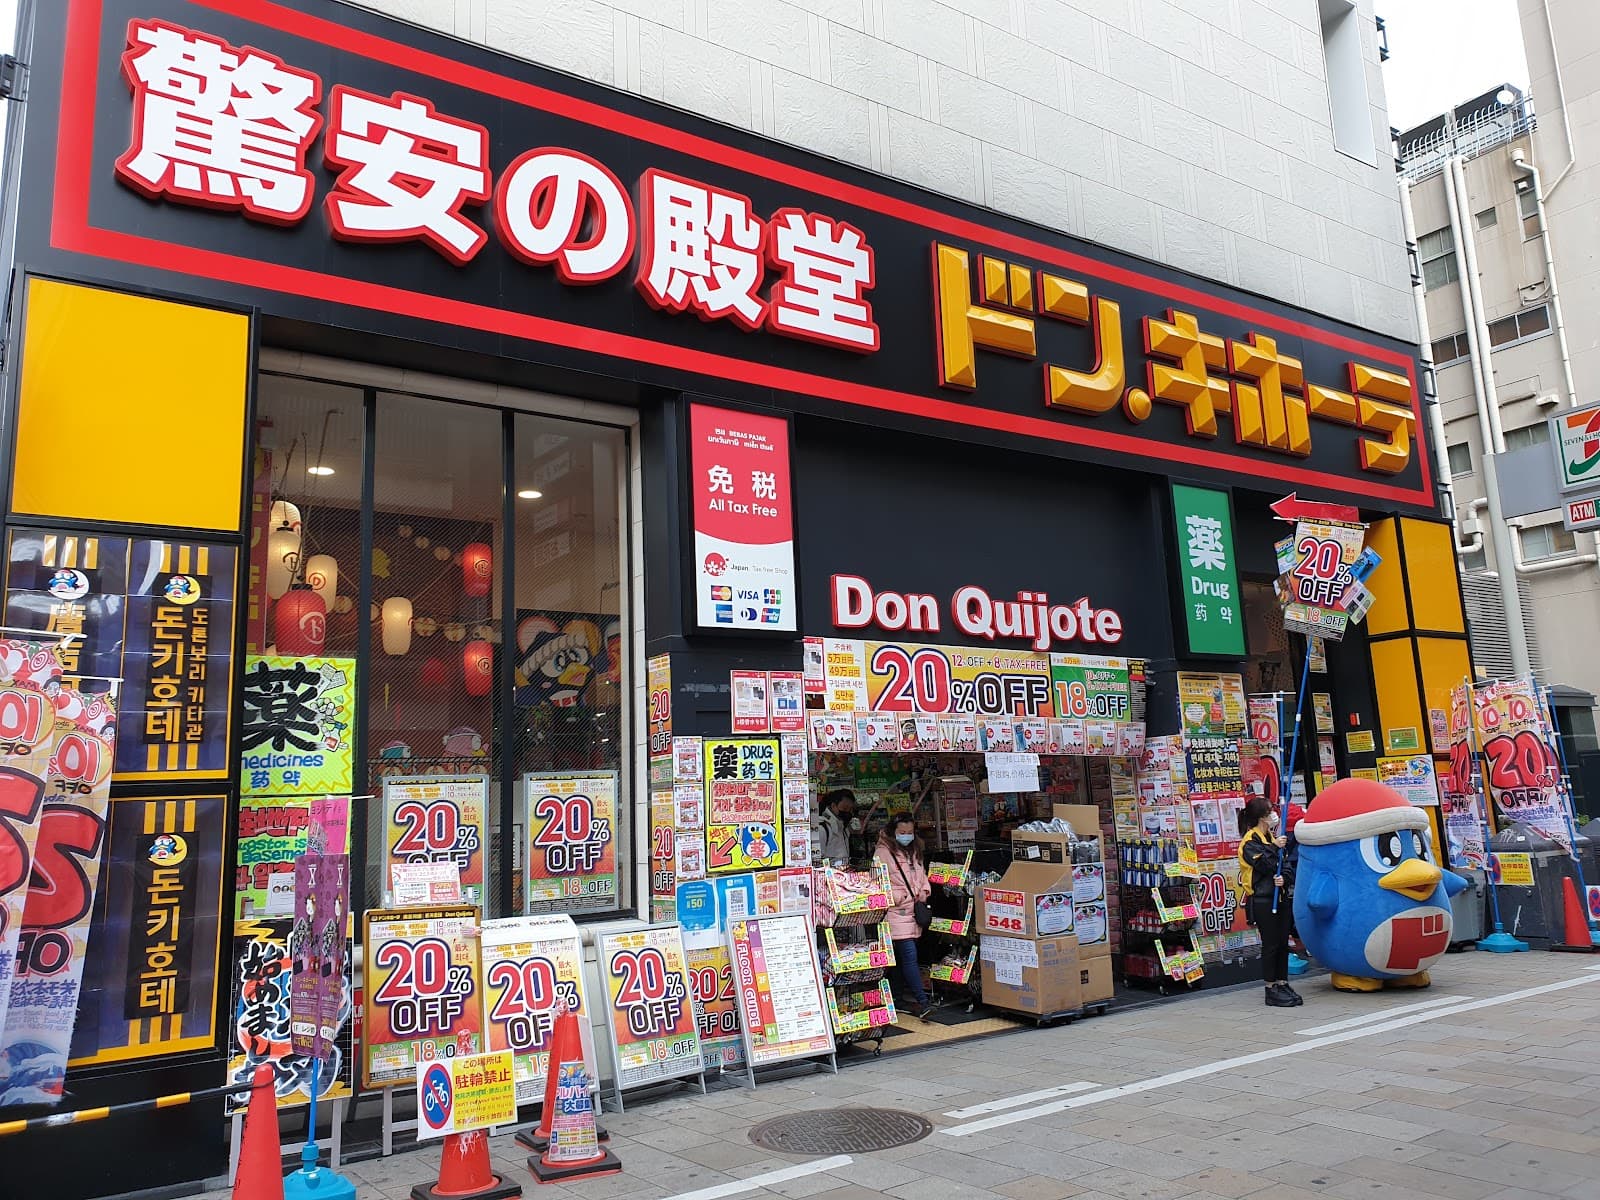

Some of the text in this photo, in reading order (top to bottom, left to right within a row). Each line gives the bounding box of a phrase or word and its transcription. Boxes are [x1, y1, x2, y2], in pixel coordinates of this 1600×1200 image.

[117, 18, 881, 354] 驚安の殿堂
[709, 498, 778, 517] All Tax Free
[1572, 502, 1595, 520] ATM
[1185, 514, 1226, 572] 薬
[731, 563, 749, 571] Japan
[1294, 536, 1354, 584] 20%
[737, 590, 760, 600] VISA
[1191, 576, 1231, 600] Drug
[1298, 577, 1345, 606] OFF
[831, 574, 1125, 652] Don Quijote
[1194, 602, 1208, 623] 药
[1219, 606, 1233, 624] 약
[145, 604, 186, 743] 돈키호테
[967, 656, 985, 667] OFF
[1004, 658, 1047, 671] TAX-FREE
[650, 688, 671, 723] 20
[651, 731, 672, 752] OFF
[742, 745, 774, 760] DRUG
[713, 744, 738, 780] 薬
[741, 761, 756, 779] 药
[759, 760, 774, 779] 약
[251, 770, 270, 789] 药
[282, 771, 301, 786] 약
[392, 800, 478, 854] 20%
[534, 794, 610, 844] 20%
[653, 826, 674, 860] 20
[546, 842, 602, 873] OFF
[654, 871, 675, 891] OFF
[749, 925, 758, 933] 4F
[989, 914, 1022, 931] 548
[1204, 908, 1234, 931] OFF
[138, 867, 185, 1014] 돈키호테
[454, 944, 469, 952] 最大
[455, 953, 470, 961] 최대
[558, 960, 572, 969] 最大
[375, 937, 472, 1003] 20%
[611, 948, 685, 1007] 20%
[489, 956, 579, 1020] 20%
[736, 942, 761, 1028] FLOOR GUIDE
[761, 994, 770, 1003] 1F
[391, 994, 462, 1034] OFF
[629, 998, 680, 1035] OFF
[507, 1011, 552, 1050] OF
[463, 1055, 502, 1069] この場所は
[455, 1067, 511, 1090] 駐輪禁止
